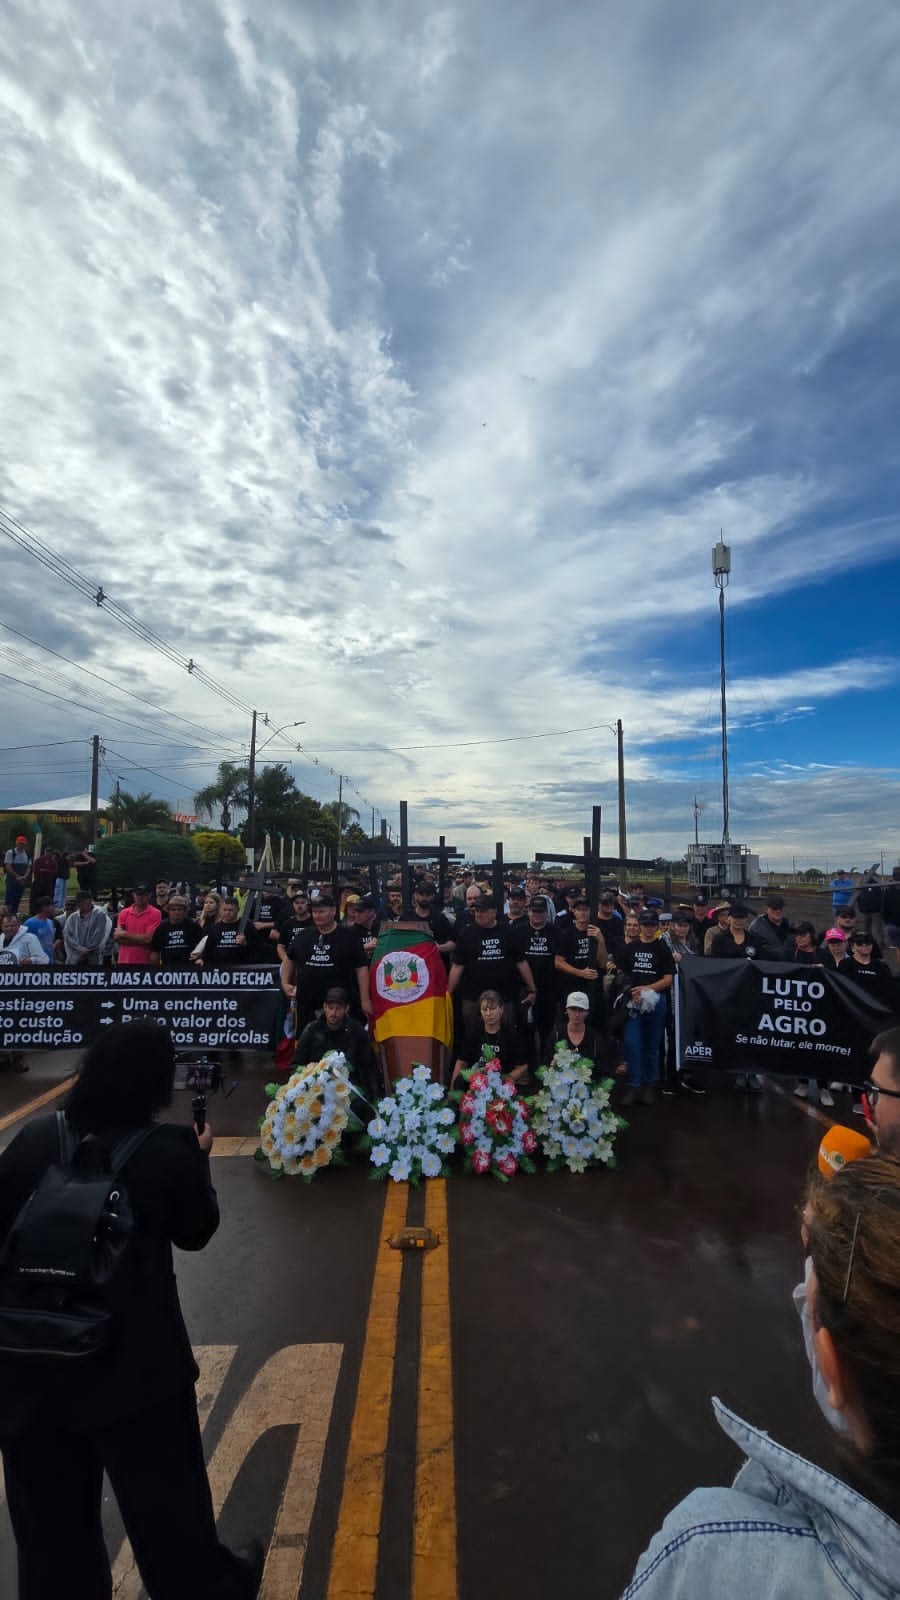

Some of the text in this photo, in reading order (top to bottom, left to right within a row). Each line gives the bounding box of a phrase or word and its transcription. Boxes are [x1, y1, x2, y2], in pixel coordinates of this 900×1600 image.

[53, 972, 107, 988] RESISTE,
[110, 972, 140, 985] MAS
[142, 972, 152, 985] A
[154, 972, 199, 985] CONTA
[201, 968, 230, 985] NÃO
[232, 972, 274, 985] FECHA
[762, 977, 825, 999] LUTO
[122, 996, 238, 1011] Uma enchente
[773, 998, 812, 1012] PELO
[18, 1016, 64, 1028] custo
[172, 1014, 212, 1028] valor
[216, 1014, 246, 1028] dos
[757, 1013, 827, 1036] AGRO
[3, 1029, 83, 1046] produção
[198, 1029, 270, 1046] agrícolas
[735, 1033, 851, 1056] Se não lutar, ele morre!
[684, 1046, 713, 1057] APER
